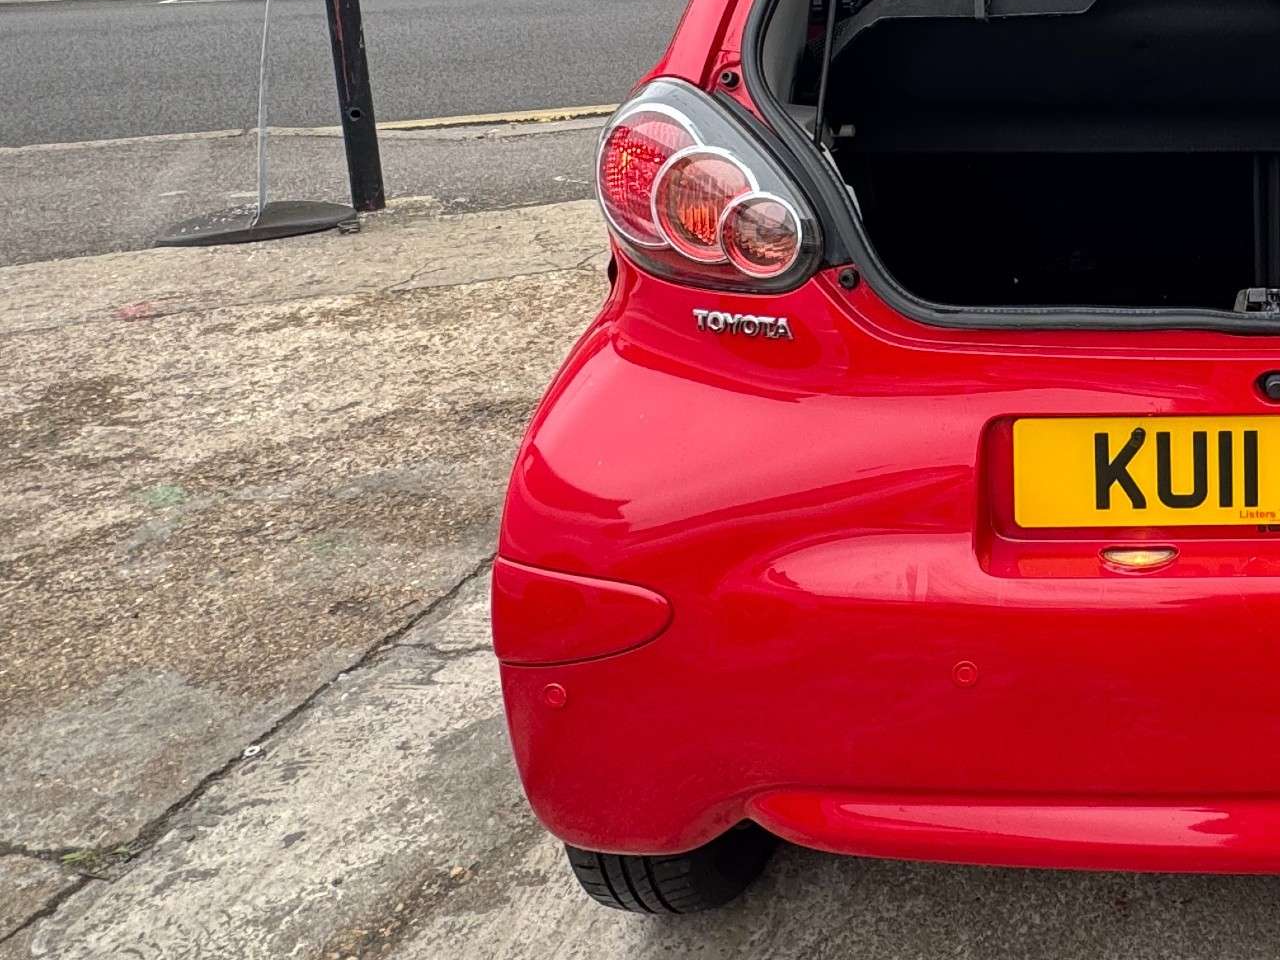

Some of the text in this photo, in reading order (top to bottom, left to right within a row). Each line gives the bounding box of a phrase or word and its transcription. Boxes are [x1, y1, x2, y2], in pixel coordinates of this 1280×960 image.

[692, 308, 793, 340] TOYOTA
[1094, 428, 1258, 510] KU11
[1239, 509, 1276, 520] Listers
